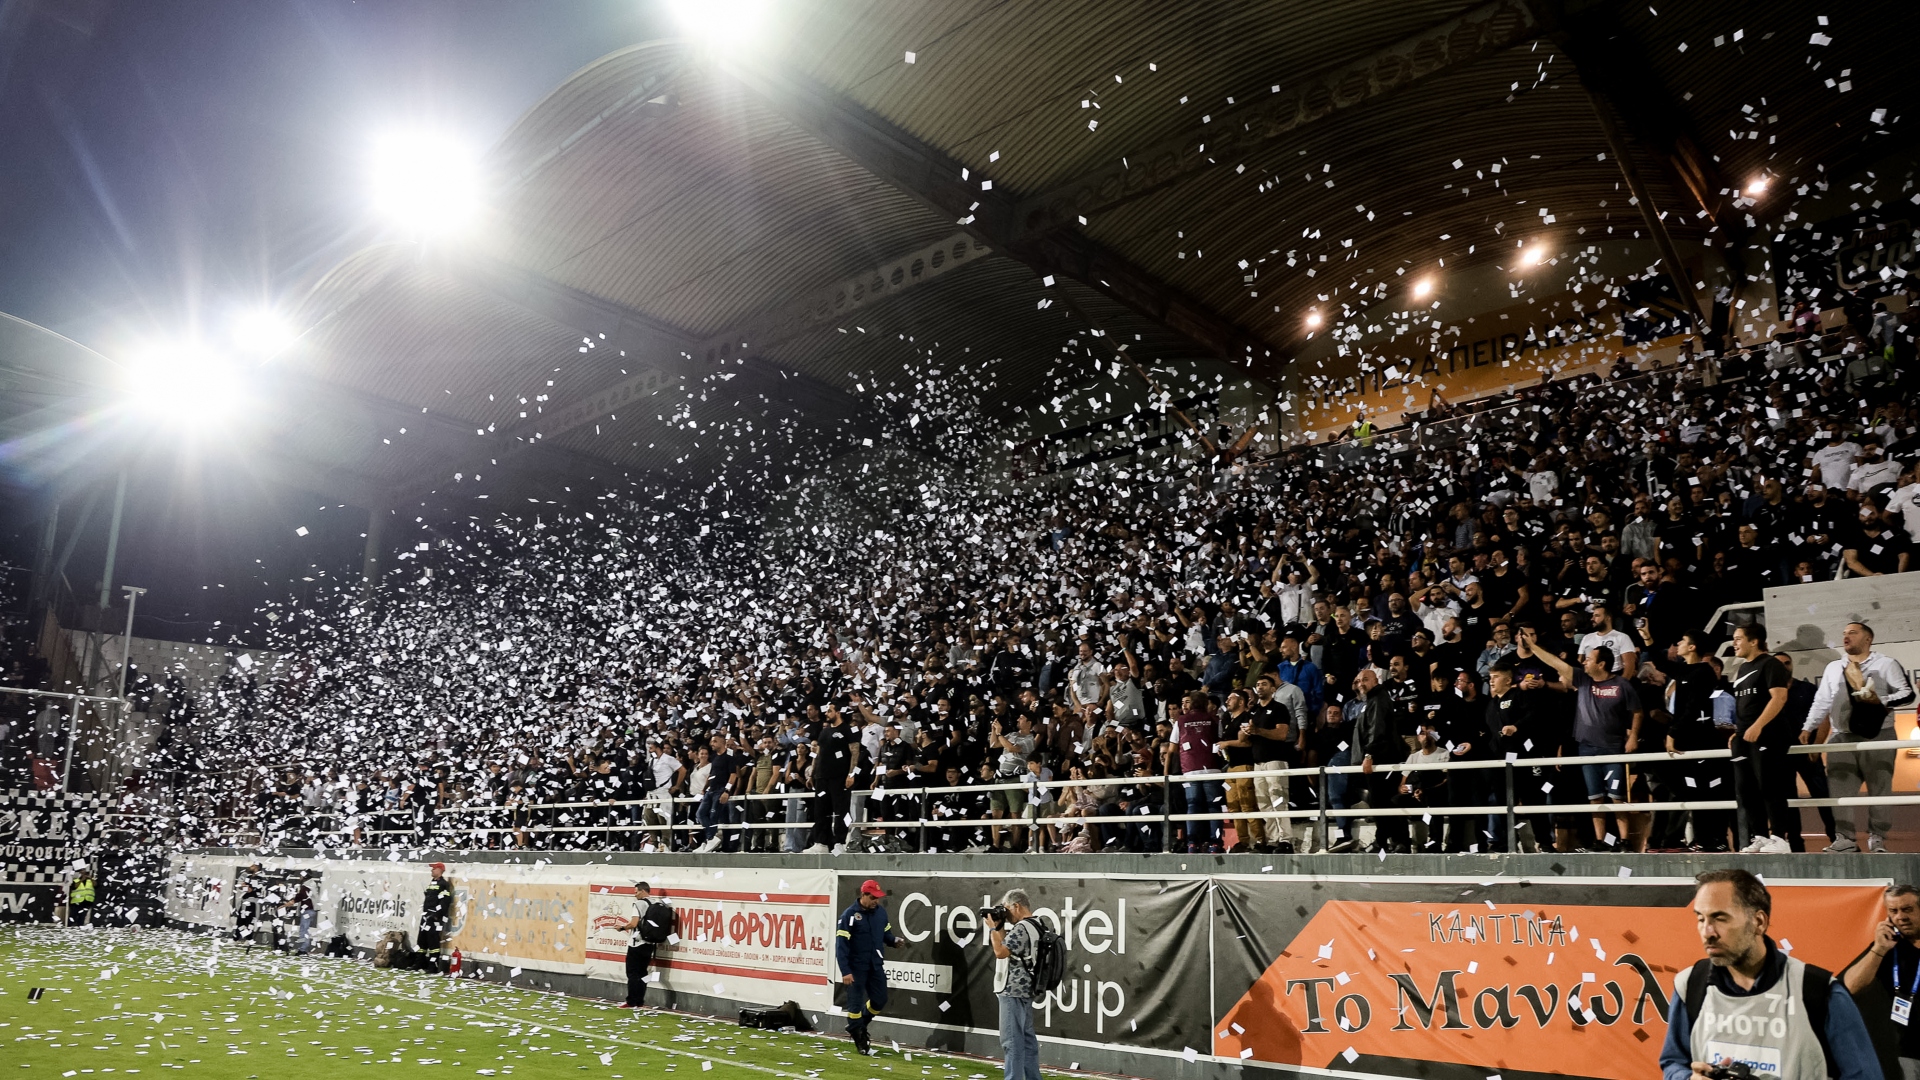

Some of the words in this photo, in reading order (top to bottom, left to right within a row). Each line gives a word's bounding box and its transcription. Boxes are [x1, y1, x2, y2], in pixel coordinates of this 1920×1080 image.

[729, 911, 807, 951] ΦΡΟΥΤΑ
[898, 892, 1126, 954] Crettel
[884, 968, 941, 989] eteotel.gr
[1285, 977, 1371, 1034] Το
[1765, 993, 1795, 1015] 71
[1703, 1012, 1787, 1038] PHOTO
